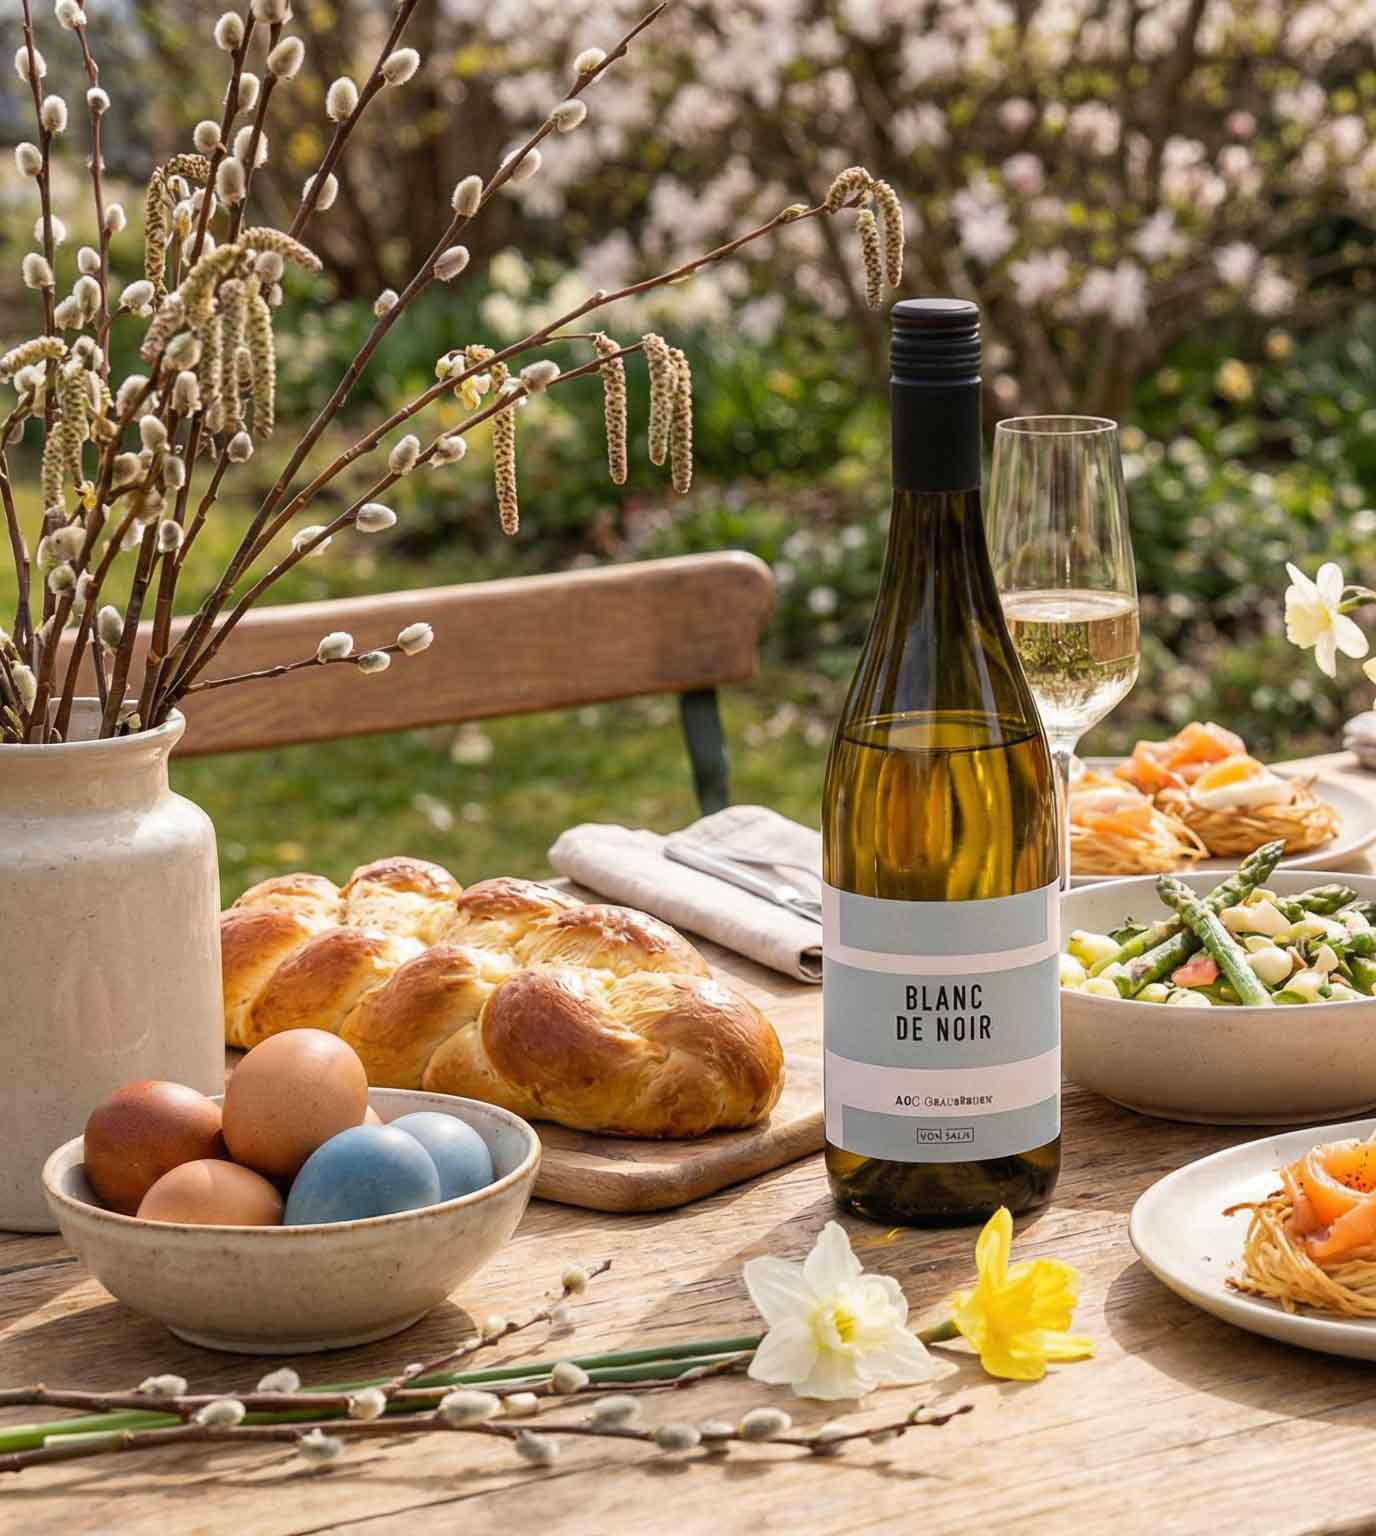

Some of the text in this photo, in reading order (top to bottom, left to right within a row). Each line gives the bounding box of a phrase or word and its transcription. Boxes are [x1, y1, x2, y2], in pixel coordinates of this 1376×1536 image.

[905, 984, 983, 1011] BLANC
[896, 1015, 992, 1042] DE NOIR
[895, 1095, 921, 1107] AOC
